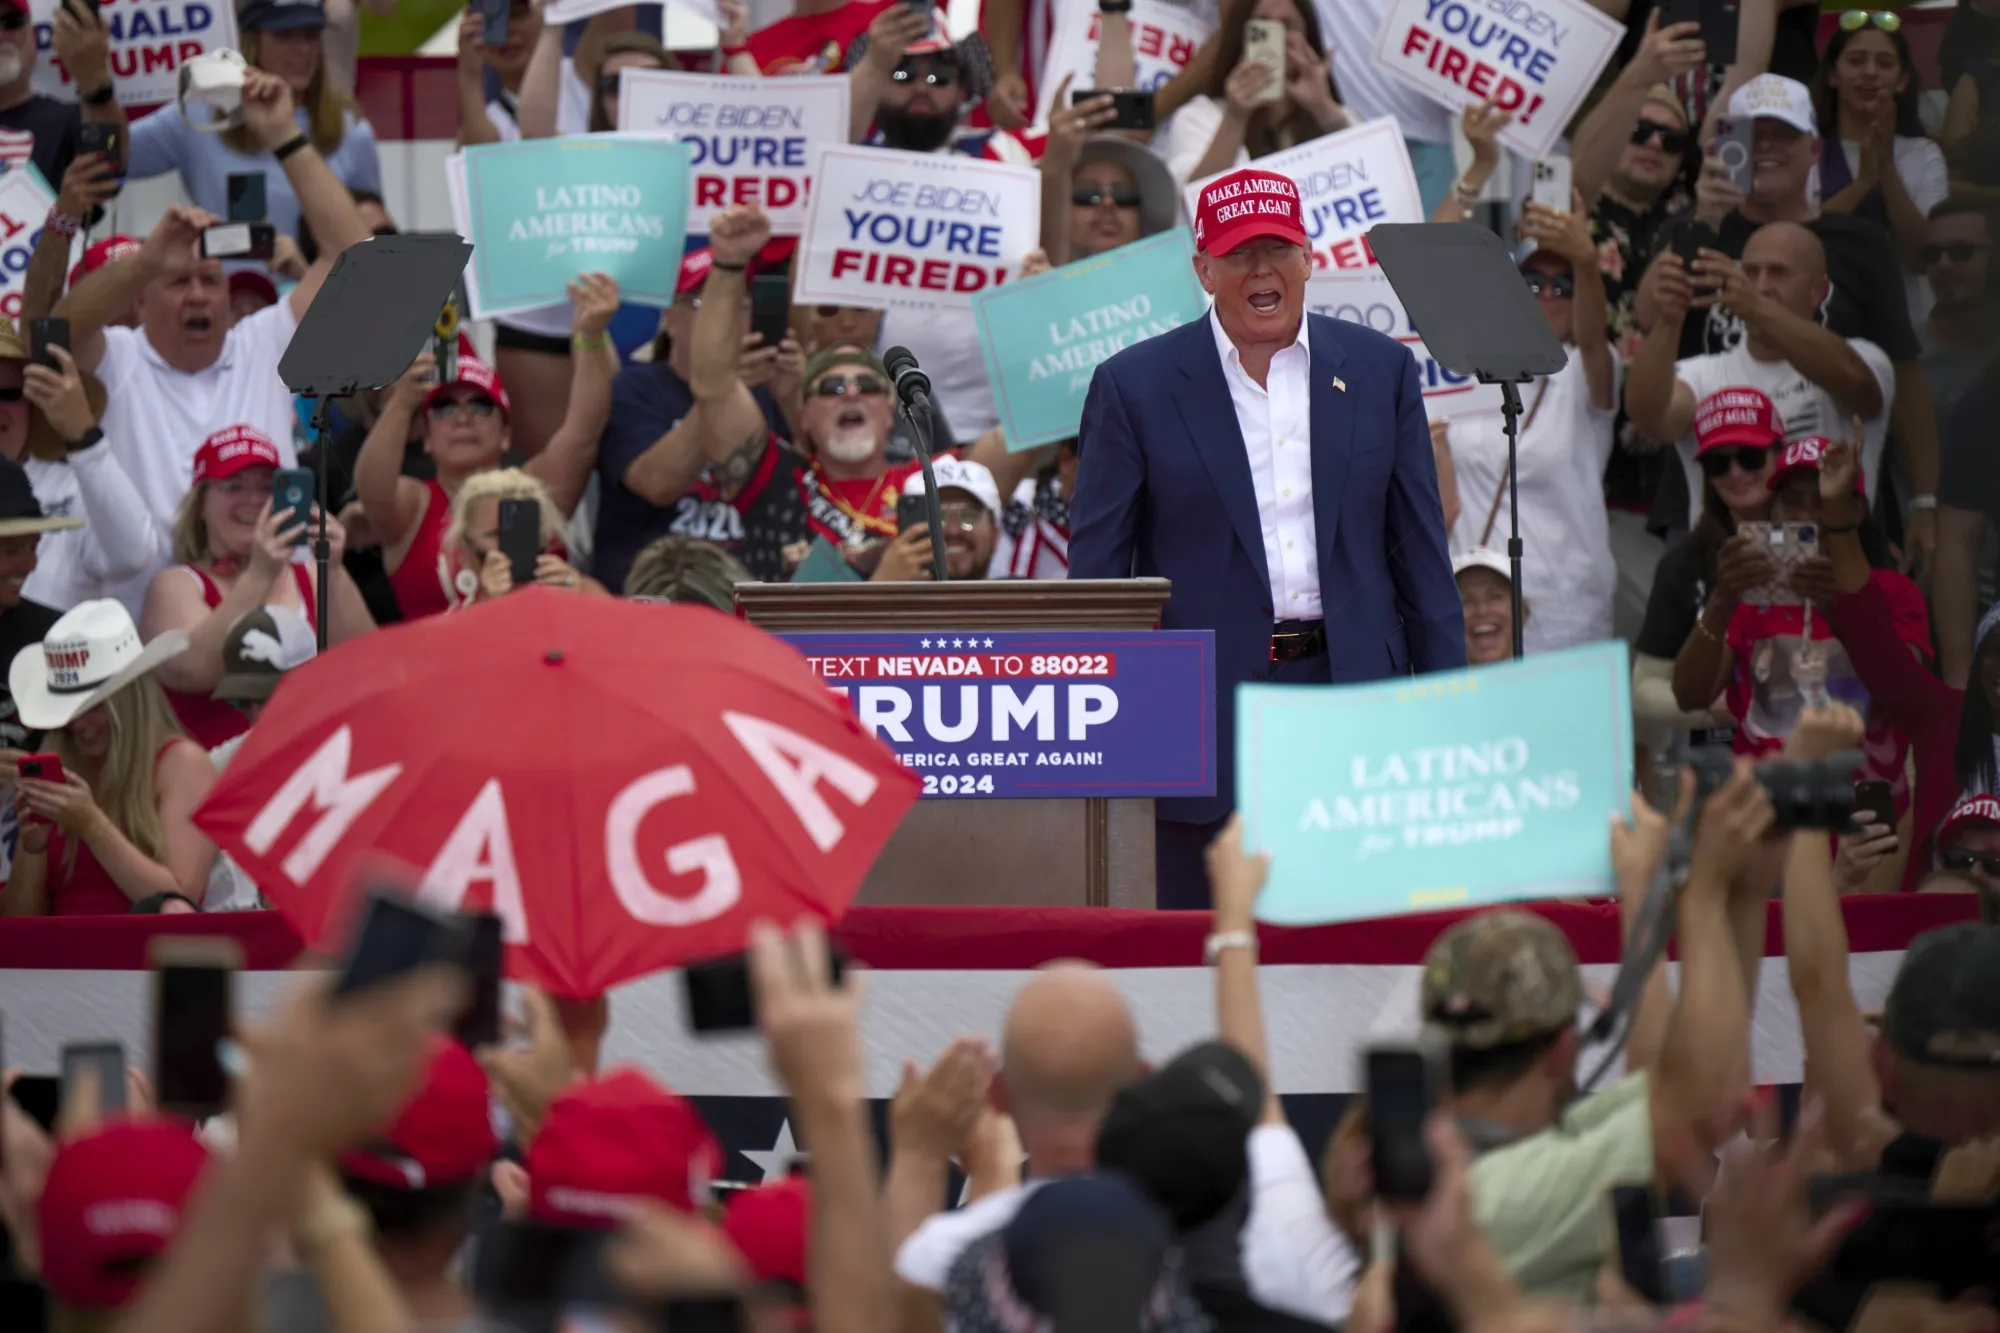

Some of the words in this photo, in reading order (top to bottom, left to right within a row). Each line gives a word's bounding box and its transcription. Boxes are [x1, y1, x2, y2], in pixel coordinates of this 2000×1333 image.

[34, 3, 213, 50] DNALD
[1425, 0, 1556, 85] YOU'RE
[50, 41, 205, 85] TUMP
[1402, 24, 1545, 126] FIRED!
[656, 102, 714, 128] JOE
[676, 133, 808, 167] OU'RE
[536, 183, 642, 212] LATINO
[695, 174, 812, 209] RED!
[853, 178, 914, 206] JOE
[1207, 181, 1241, 206] MAKE
[1243, 179, 1296, 198] AMERICA
[508, 210, 664, 241] AMERICANS
[1217, 200, 1255, 223] GREAT
[1258, 199, 1291, 217] AGAIN
[843, 208, 1003, 258] YOU'RE
[830, 247, 1008, 294] FIRED!
[1049, 294, 1152, 346] LATINO
[807, 658, 870, 677] TEXT
[877, 657, 984, 676] NEVADA
[990, 656, 1024, 675] TO
[1030, 655, 1109, 675] 88022
[827, 684, 1119, 743] RUMP
[967, 753, 1029, 766] GREAT
[1036, 752, 1103, 766] AGAIN!
[1350, 736, 1530, 789] LATINO
[923, 775, 995, 795] 2024
[1299, 770, 1581, 832] AMERICANS
